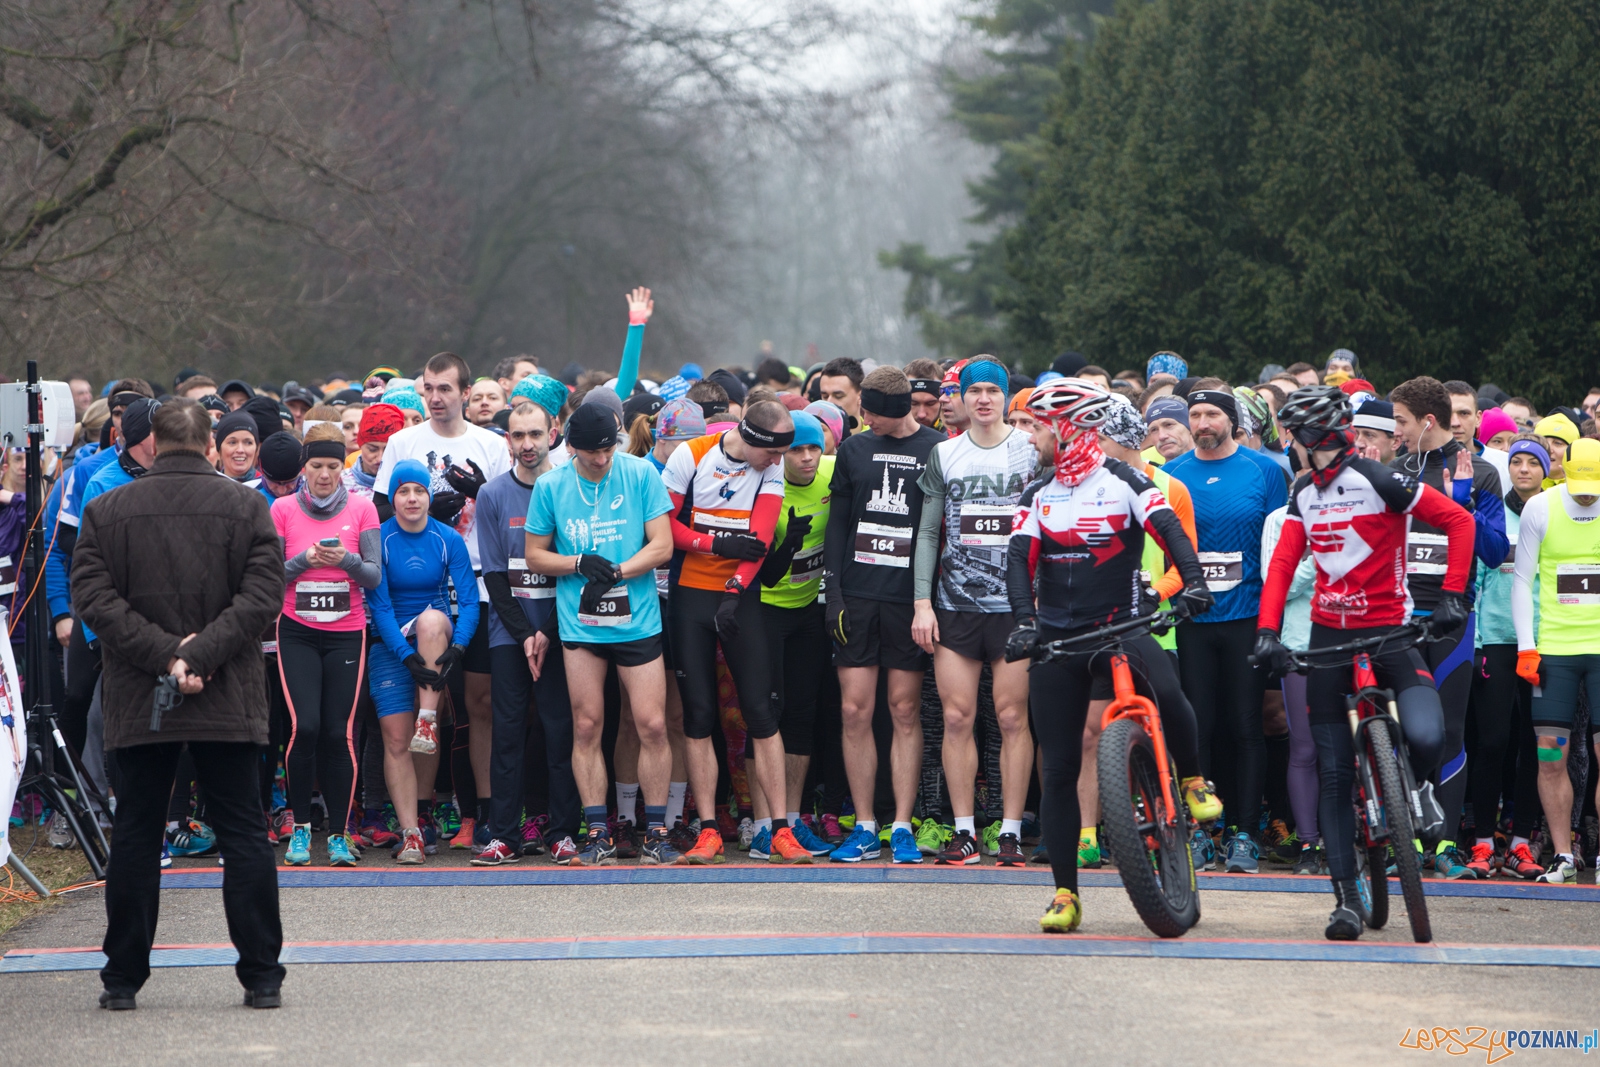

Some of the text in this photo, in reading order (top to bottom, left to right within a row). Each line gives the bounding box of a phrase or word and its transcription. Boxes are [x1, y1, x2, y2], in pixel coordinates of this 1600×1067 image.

[975, 519, 1000, 531] 615
[870, 538, 895, 551] 164
[1415, 547, 1433, 560] 57
[1202, 566, 1227, 578] 753
[523, 573, 547, 585] 306
[1580, 578, 1589, 590] 1
[310, 596, 335, 608] 511
[596, 601, 617, 613] 30
